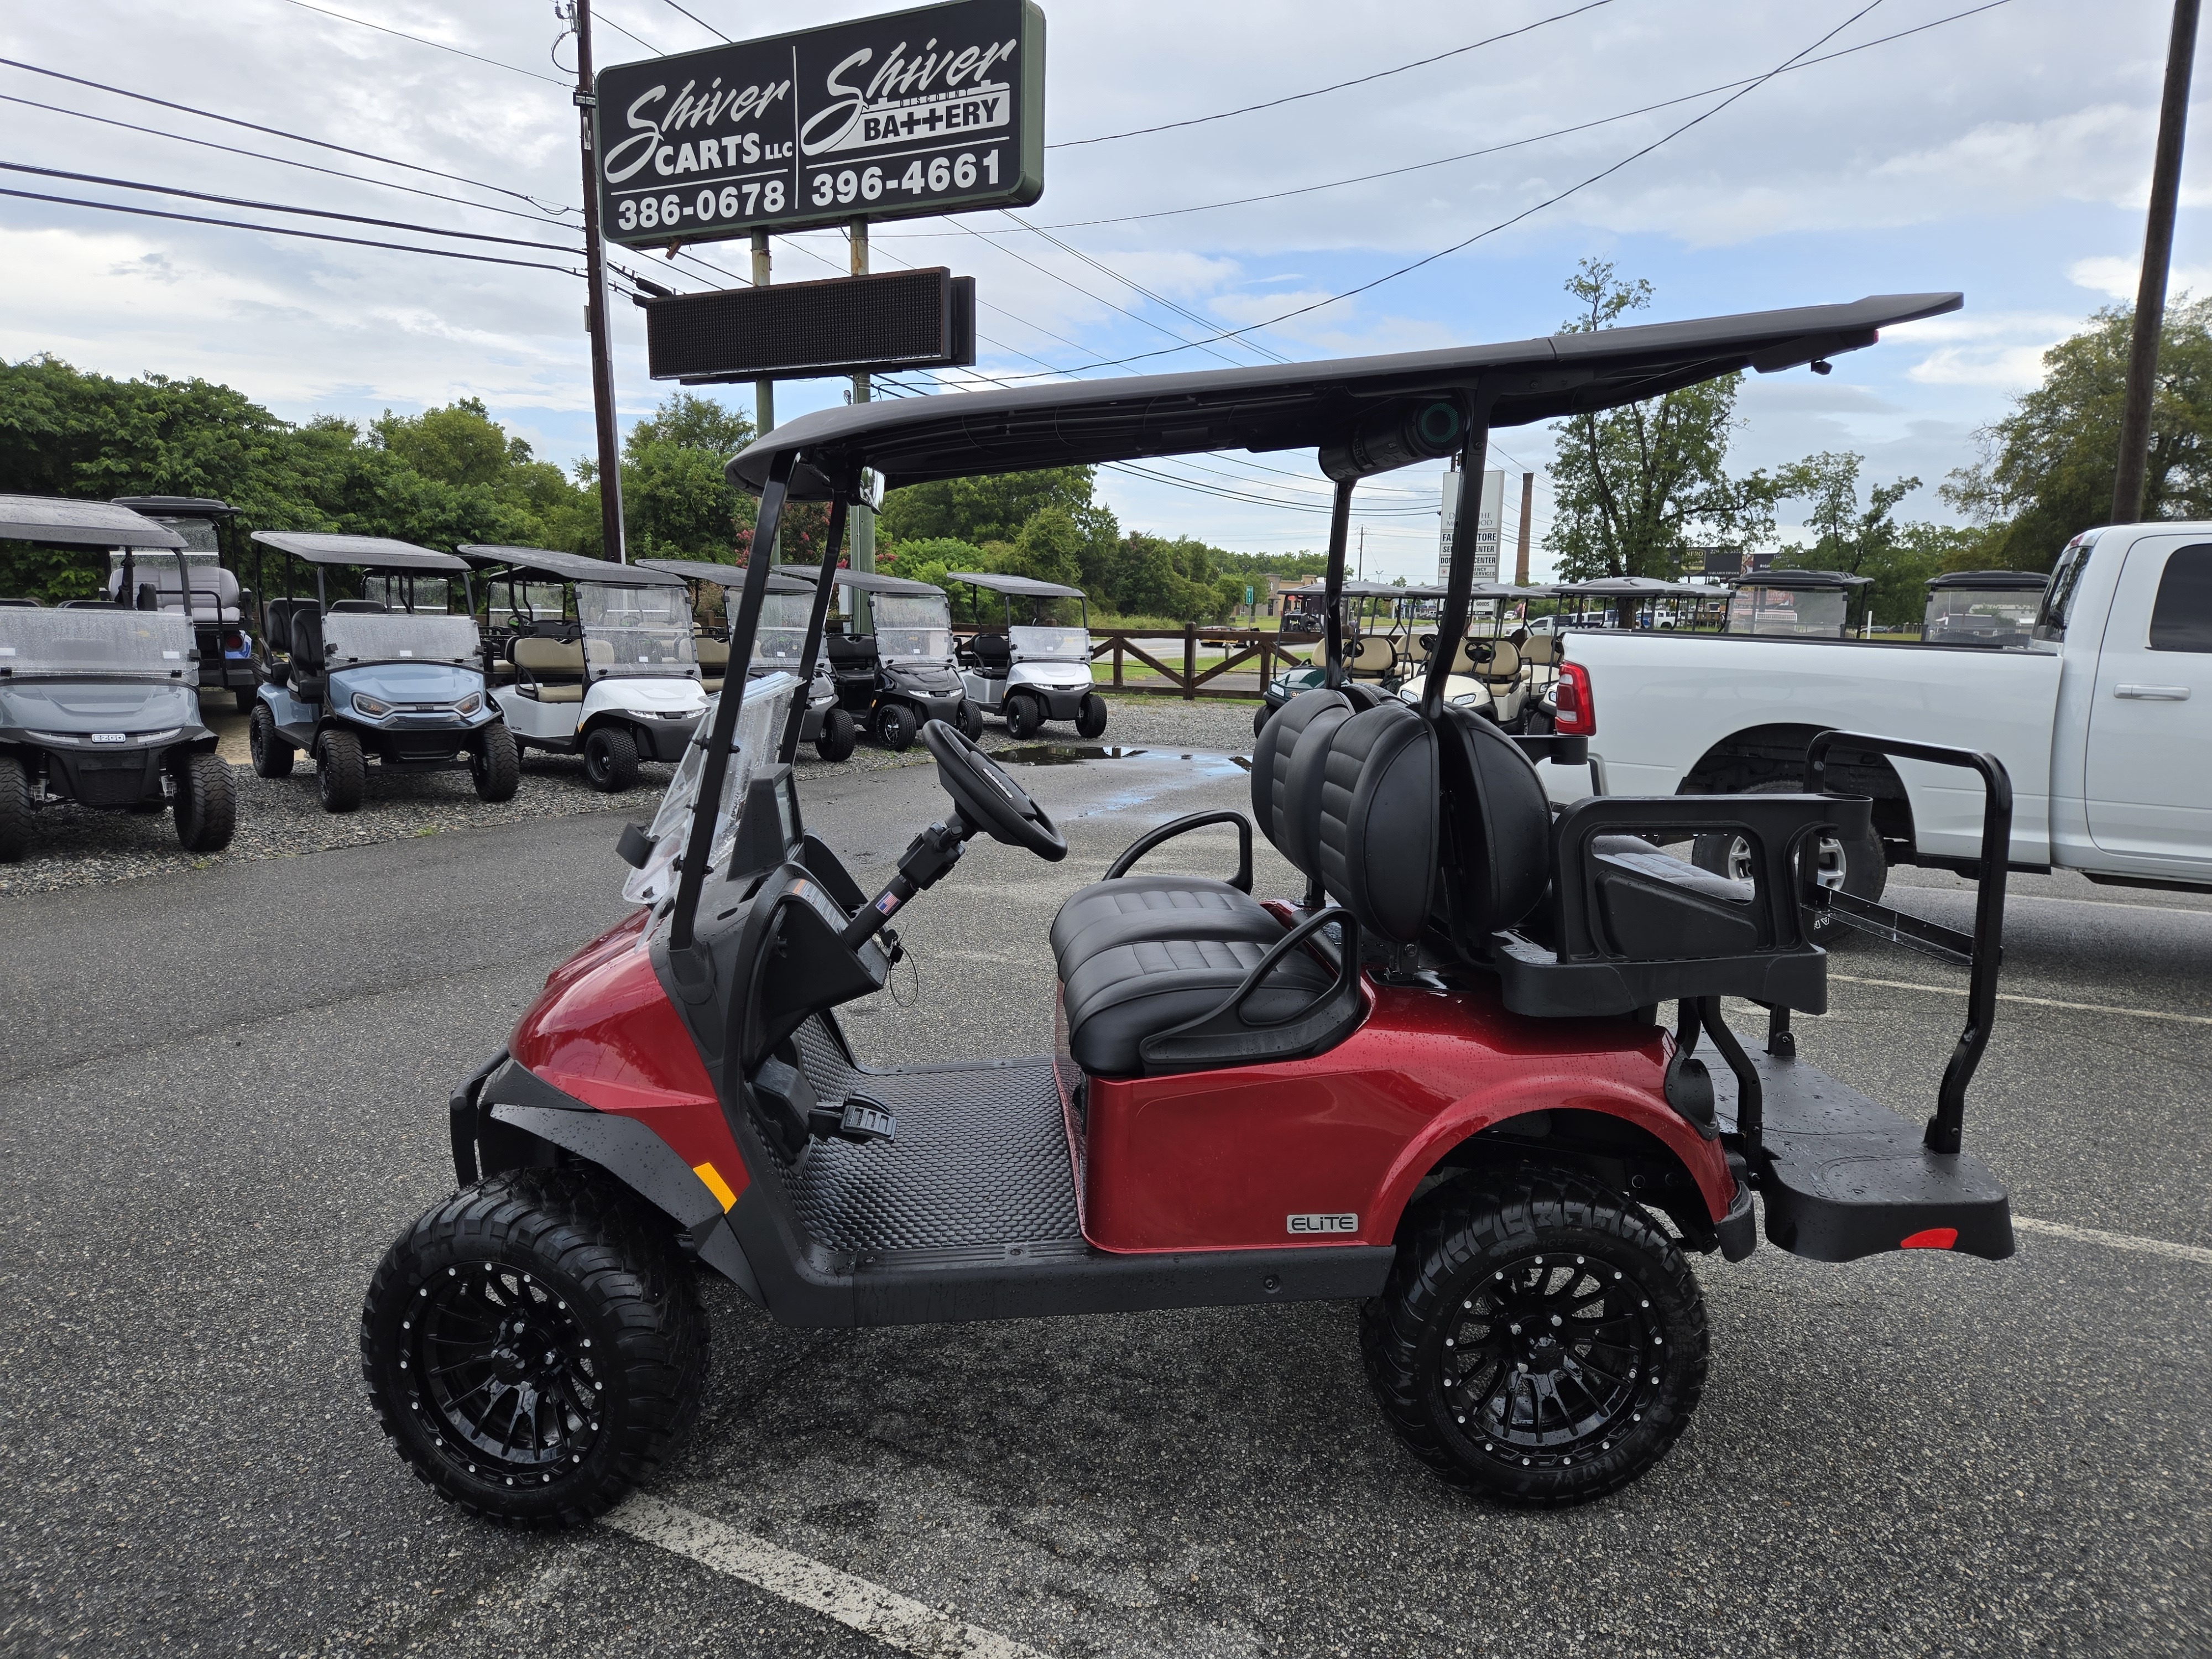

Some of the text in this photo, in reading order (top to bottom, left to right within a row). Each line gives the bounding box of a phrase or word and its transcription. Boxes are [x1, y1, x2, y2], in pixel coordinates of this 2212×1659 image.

[800, 38, 1017, 156] Shiver
[900, 88, 969, 108] DISCOUNT
[604, 77, 791, 184] Shiver
[655, 132, 793, 176] CARTS LLC
[812, 149, 999, 207] 396-4661
[618, 180, 785, 231] 386-0678
[1478, 533, 1496, 541] TORE
